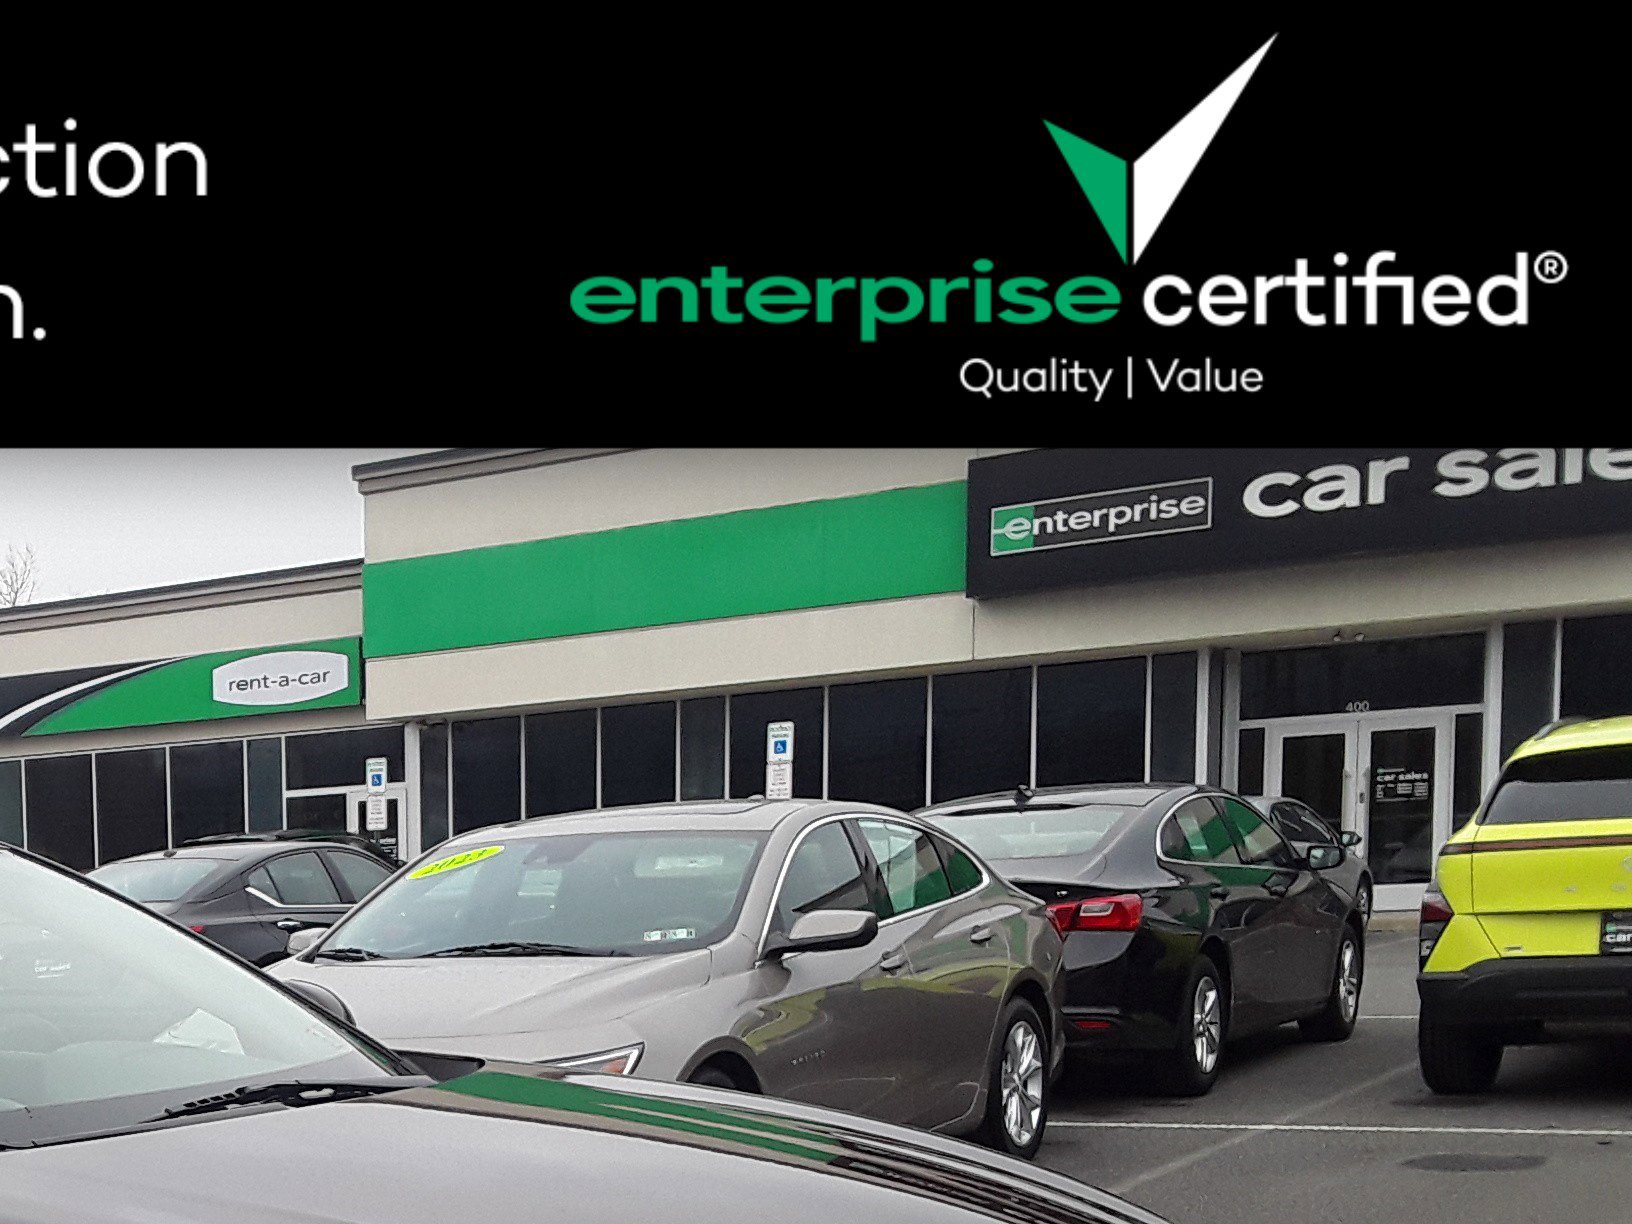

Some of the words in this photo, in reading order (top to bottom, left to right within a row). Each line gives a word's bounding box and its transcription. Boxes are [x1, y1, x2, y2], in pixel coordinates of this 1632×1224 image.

[1003, 494, 1207, 541] enterprise
[1242, 455, 1410, 518] car
[228, 670, 330, 692] rent-a-car
[1345, 700, 1370, 713] 400
